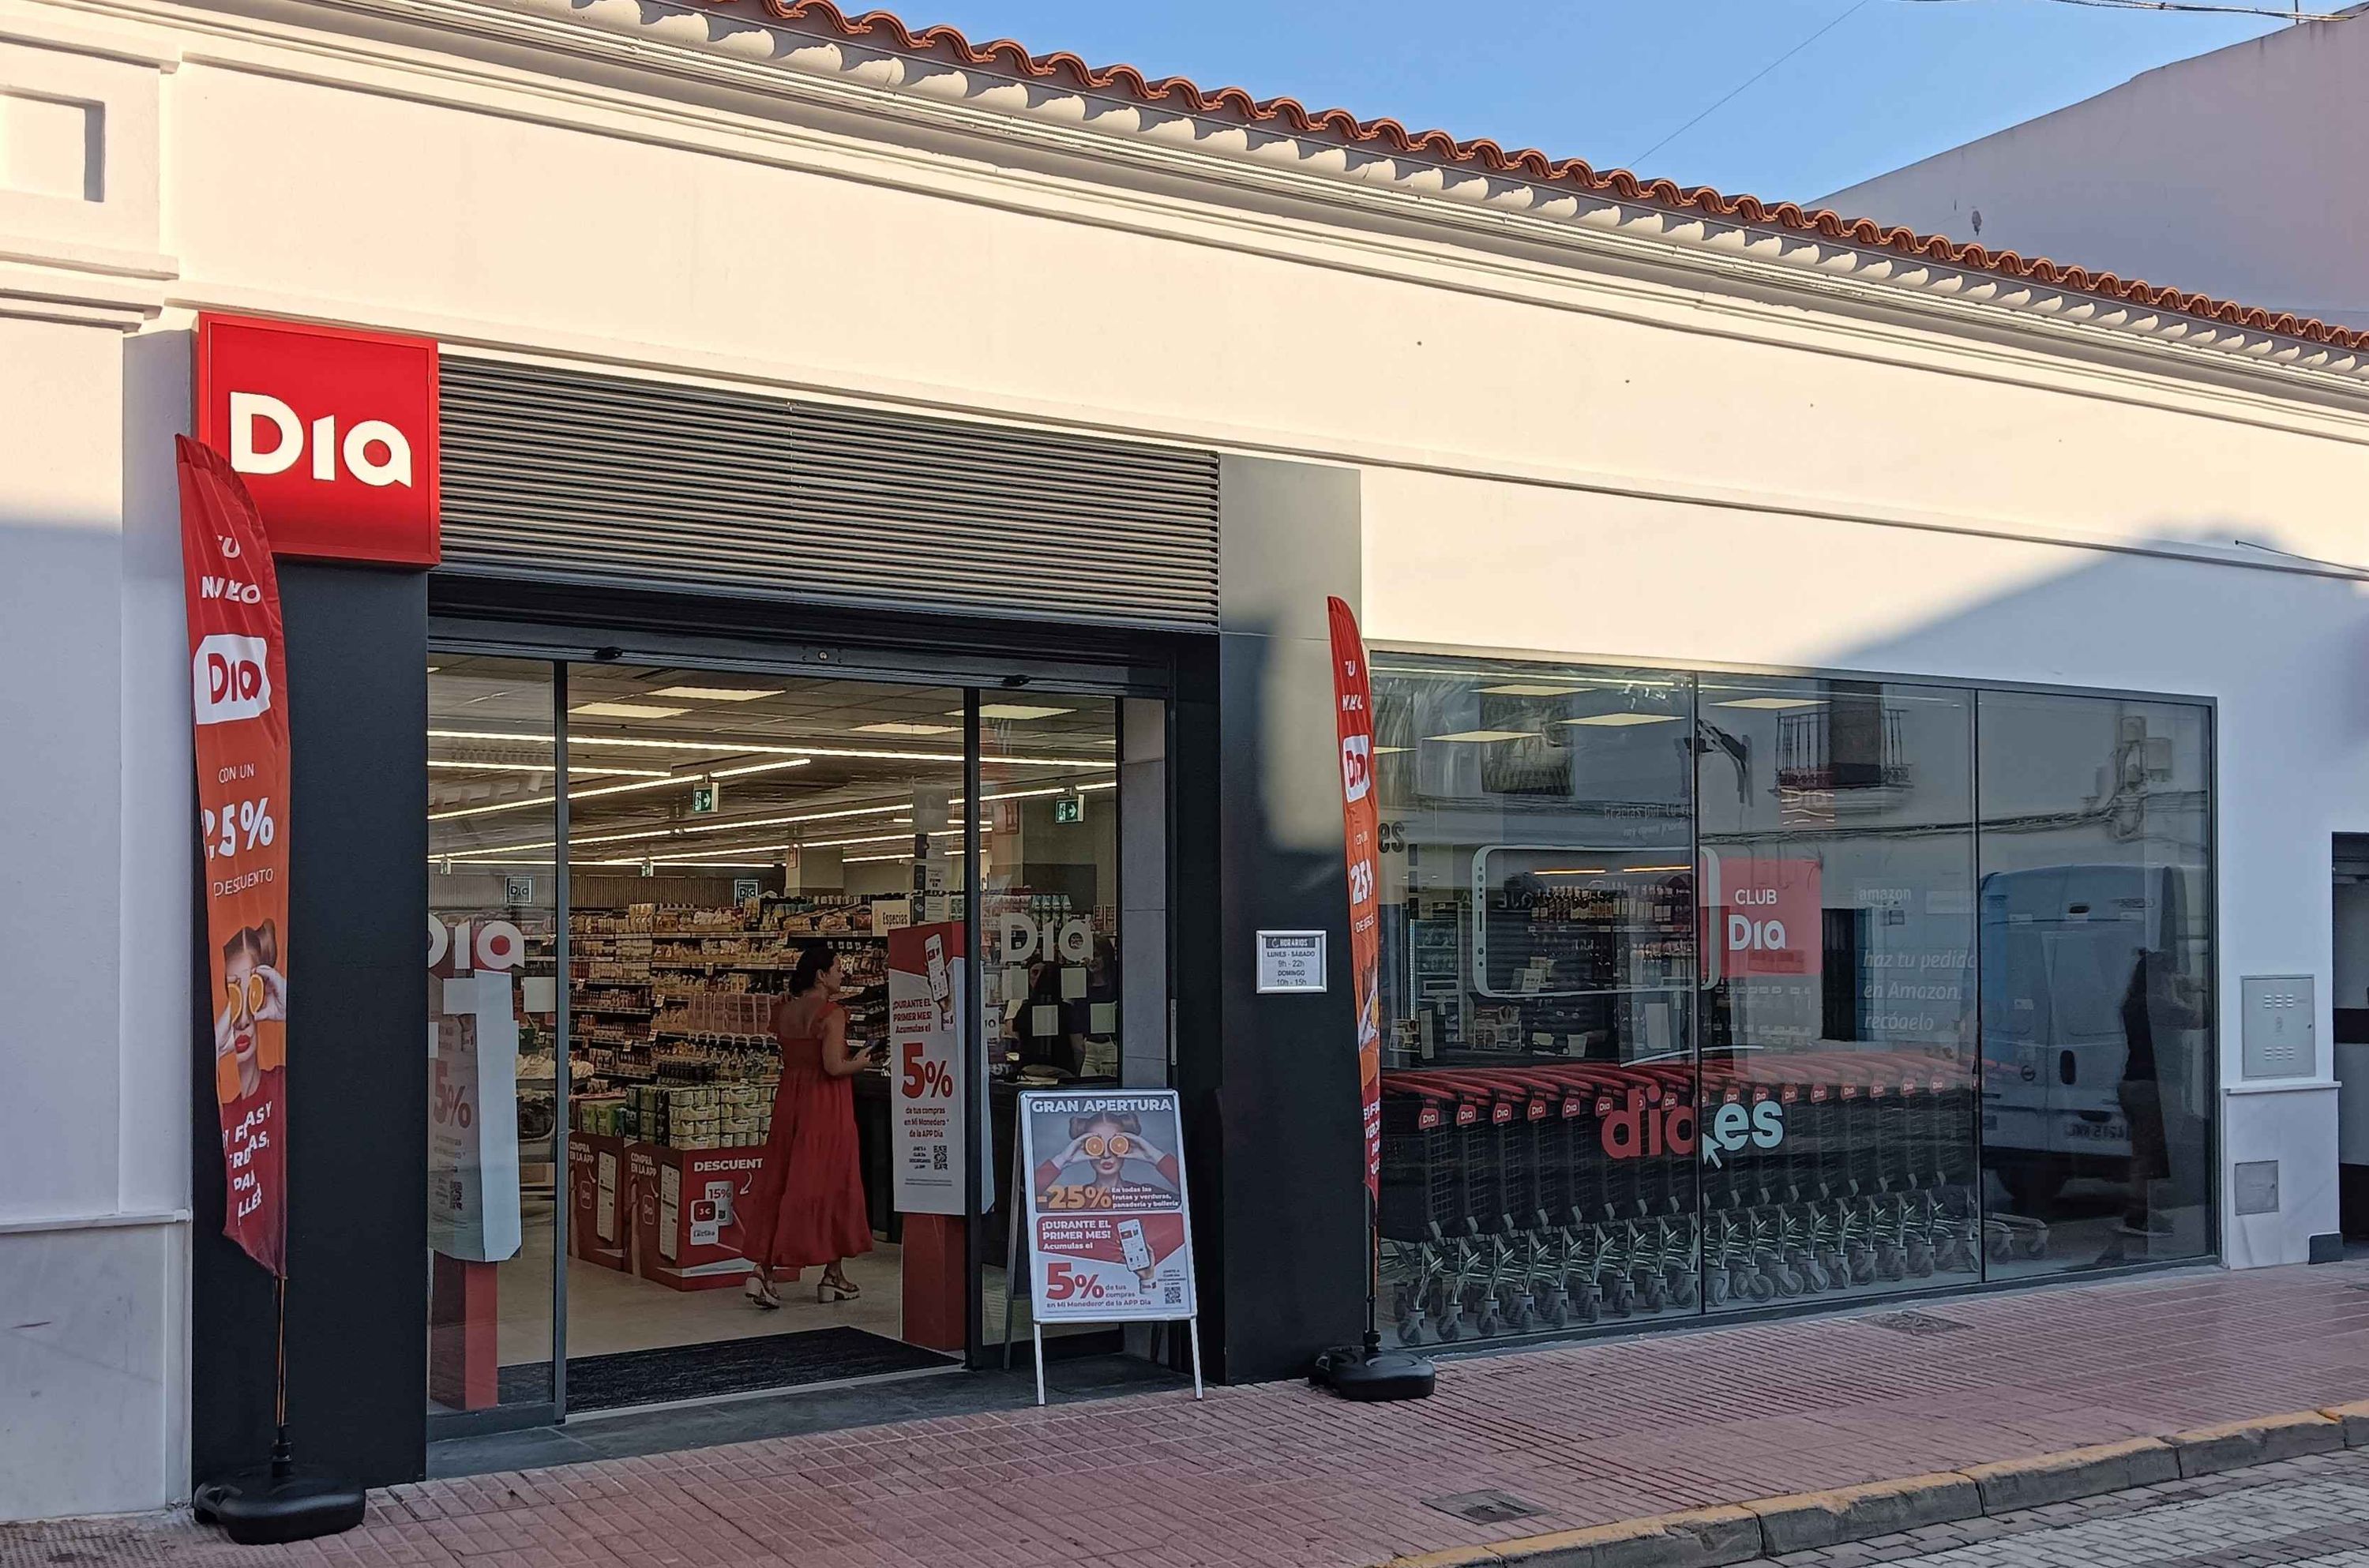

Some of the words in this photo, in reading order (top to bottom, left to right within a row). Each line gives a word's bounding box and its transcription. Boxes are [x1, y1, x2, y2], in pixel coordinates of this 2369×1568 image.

[217, 535, 240, 558] U
[239, 763, 255, 778] UN
[1735, 889, 1778, 905] CLUB
[1859, 888, 1911, 901] amazon
[1864, 950, 1893, 967] haz
[1864, 984, 1883, 998] en
[1887, 981, 1962, 1000] Amazon.
[902, 1042, 953, 1098] 5%
[1032, 1100, 1079, 1112] GRAN
[1083, 1098, 1173, 1112] APERTURA
[1042, 1221, 1096, 1232] ¡DURANTE
[1098, 1220, 1111, 1229] EL
[1043, 1231, 1084, 1240] PRIMER
[1086, 1230, 1111, 1240] MES!
[1043, 1242, 1084, 1251] Acumulas
[1046, 1262, 1105, 1300] 5%
